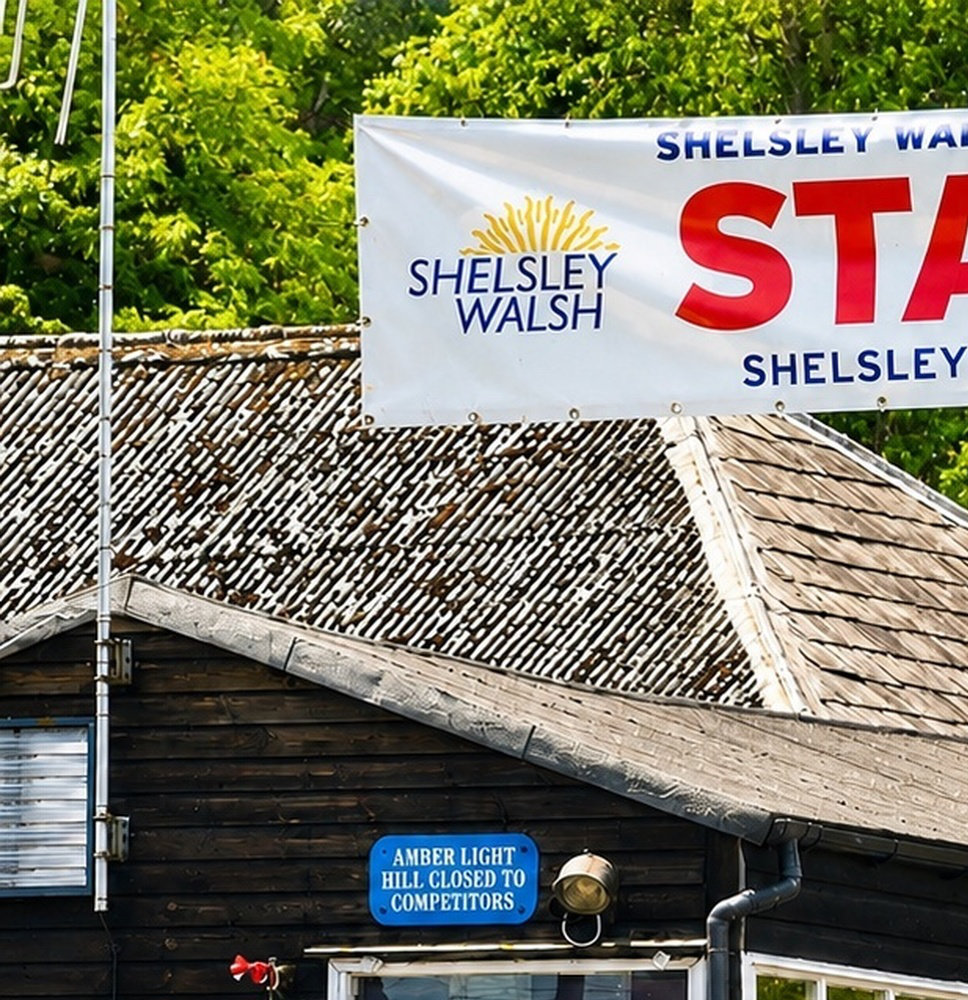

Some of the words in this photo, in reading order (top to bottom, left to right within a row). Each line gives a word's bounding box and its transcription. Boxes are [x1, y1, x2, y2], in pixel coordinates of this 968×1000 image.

[656, 124, 873, 161] SHELSLEY
[408, 251, 618, 297] SHELSLEY
[456, 293, 604, 335] WALSH
[392, 847, 455, 867] AMBER
[461, 846, 516, 866] LIGHT
[381, 870, 424, 890] HILL
[428, 869, 497, 889] CLOSED
[501, 868, 526, 888] TO
[390, 891, 515, 912] COMPETITORS
